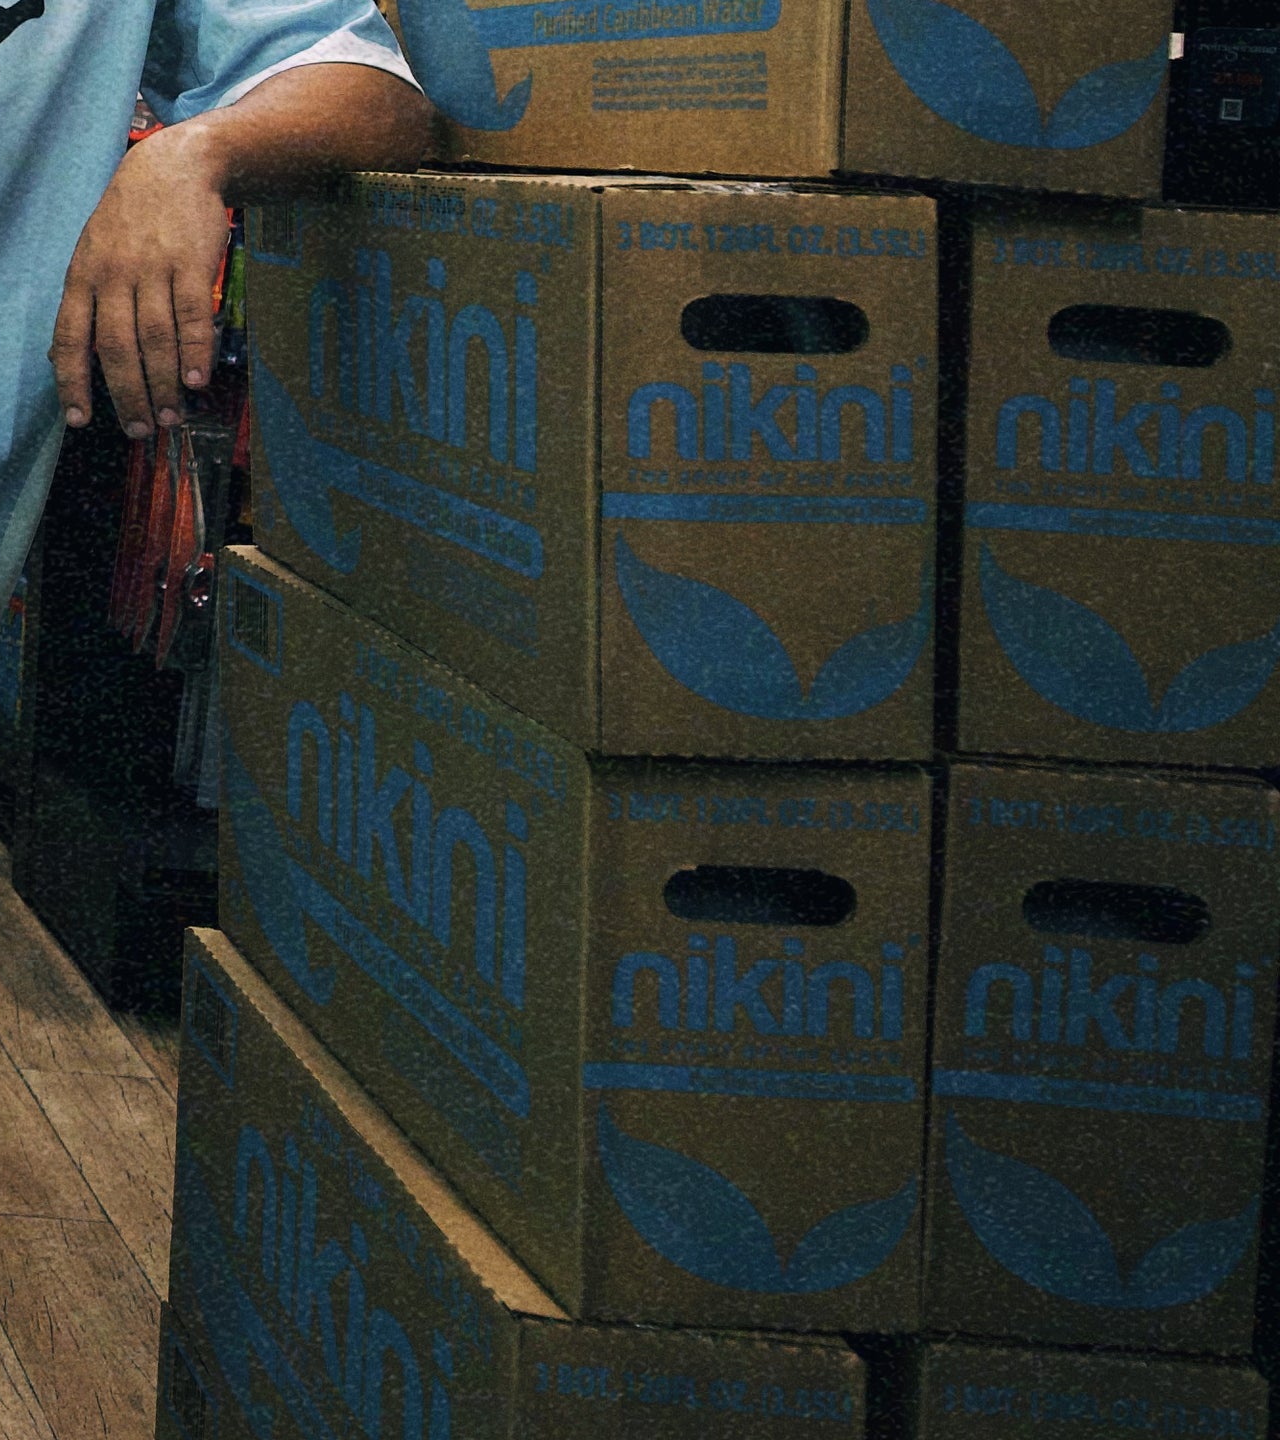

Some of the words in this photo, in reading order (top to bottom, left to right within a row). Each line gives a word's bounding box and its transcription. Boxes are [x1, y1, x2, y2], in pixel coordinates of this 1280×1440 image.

[615, 221, 632, 251] 3
[639, 220, 700, 252] BOT.
[789, 224, 834, 256] OZ.
[309, 249, 539, 474] nikini
[627, 360, 914, 464] nikini
[995, 376, 1276, 486] nikini
[286, 690, 529, 1012] nikini
[611, 933, 906, 1042] nikini
[964, 944, 1257, 1060] nikini
